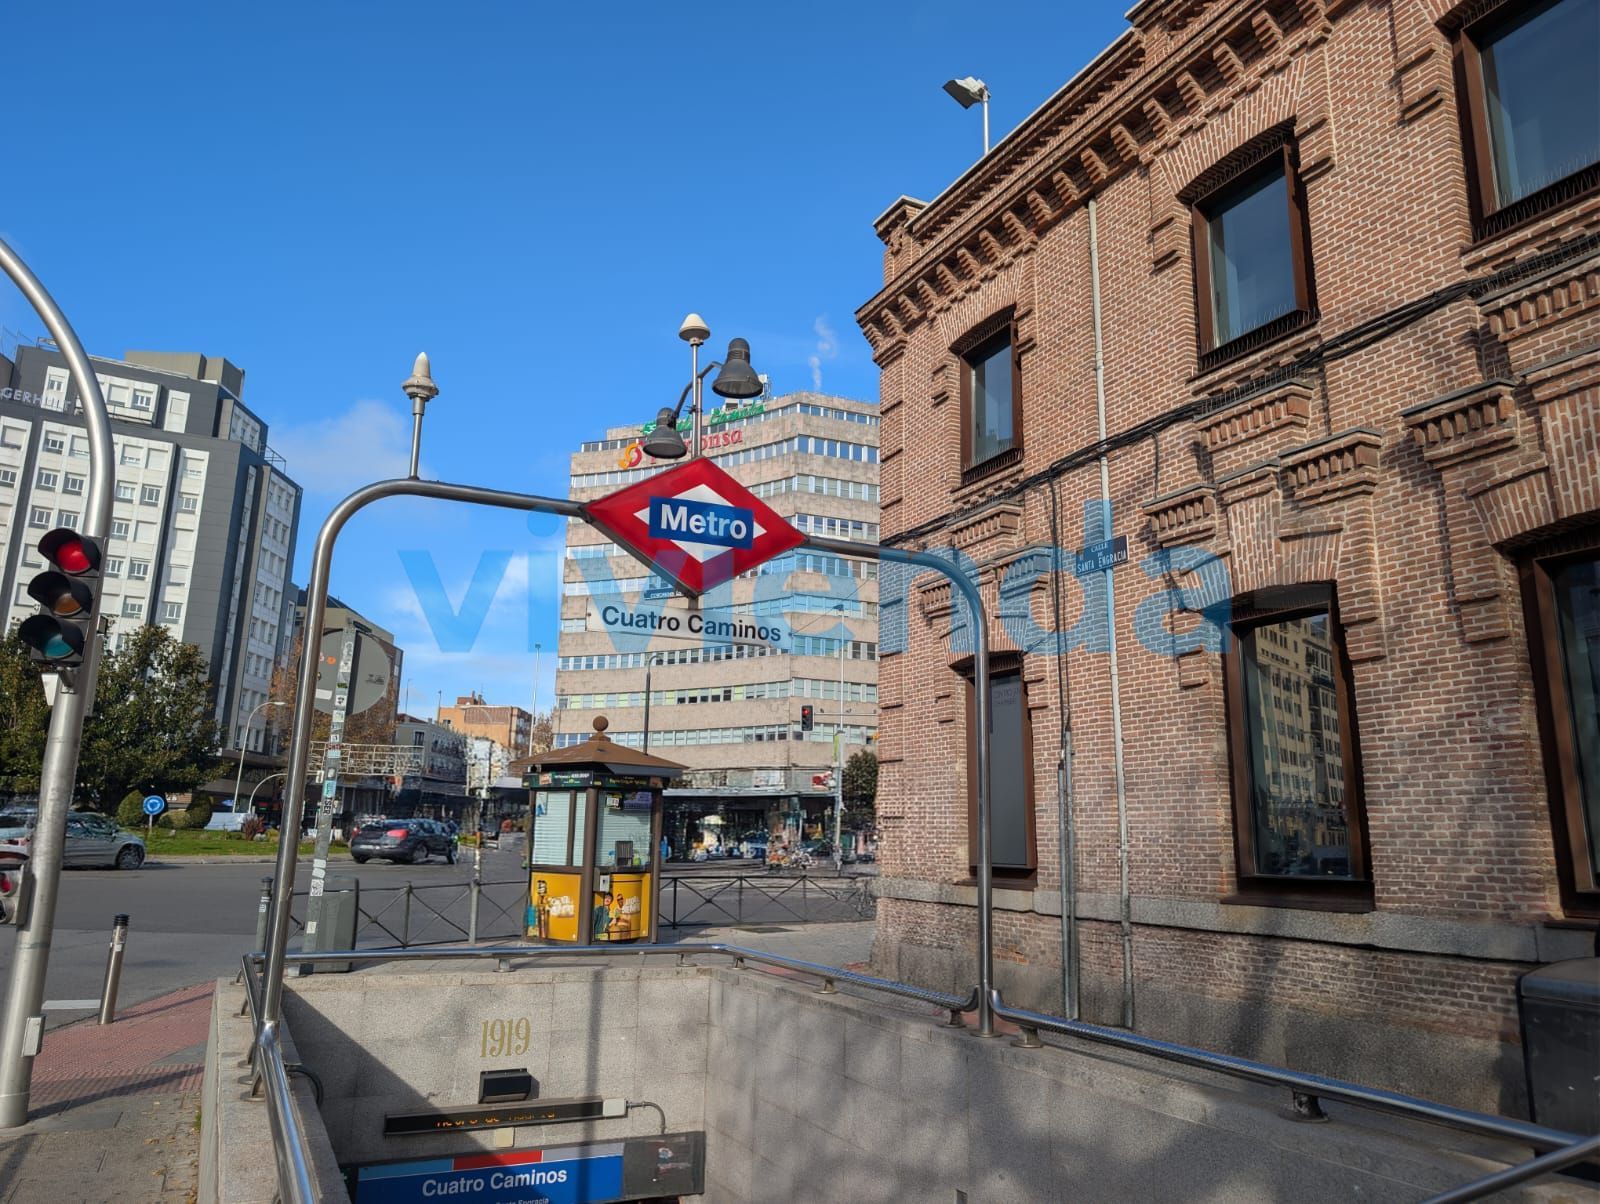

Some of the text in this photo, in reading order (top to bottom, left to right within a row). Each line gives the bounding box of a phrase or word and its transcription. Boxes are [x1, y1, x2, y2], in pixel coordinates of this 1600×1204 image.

[661, 503, 747, 540] Metro
[1077, 550, 1127, 573] SANTA ENGRACIA
[1091, 542, 1108, 552] CALLE
[602, 605, 781, 642] Cuatro Caminos
[480, 1017, 531, 1057] 1919
[422, 1169, 568, 1197] Cuatro Caminos
